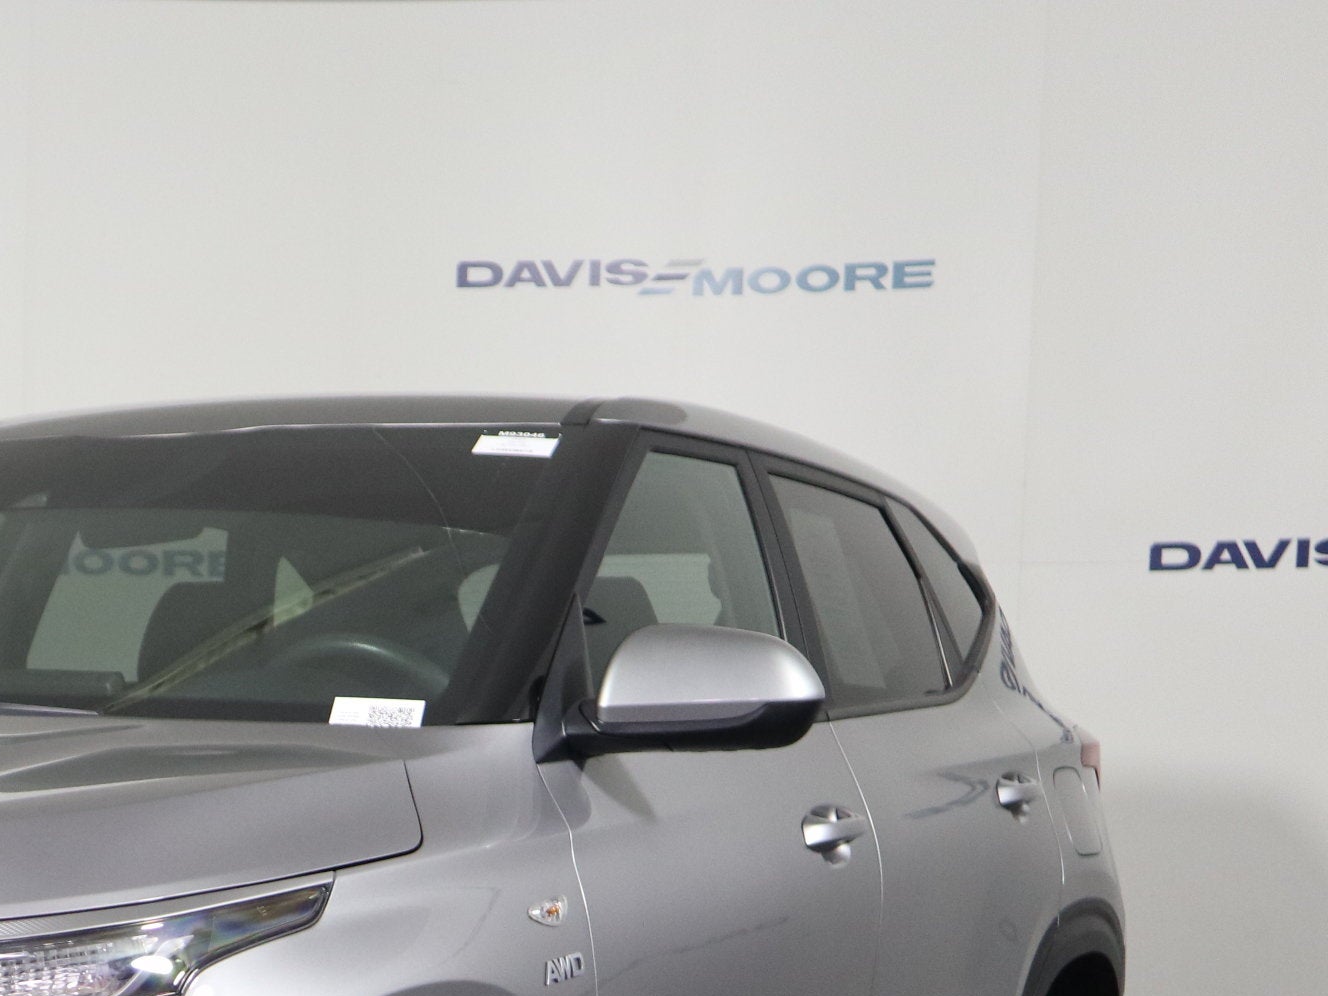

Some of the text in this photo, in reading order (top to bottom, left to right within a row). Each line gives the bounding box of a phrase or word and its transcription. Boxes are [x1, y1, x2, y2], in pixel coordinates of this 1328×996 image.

[456, 258, 936, 297] DAVIS MOORE
[62, 550, 224, 576] OORE
[544, 952, 584, 986] AWD
